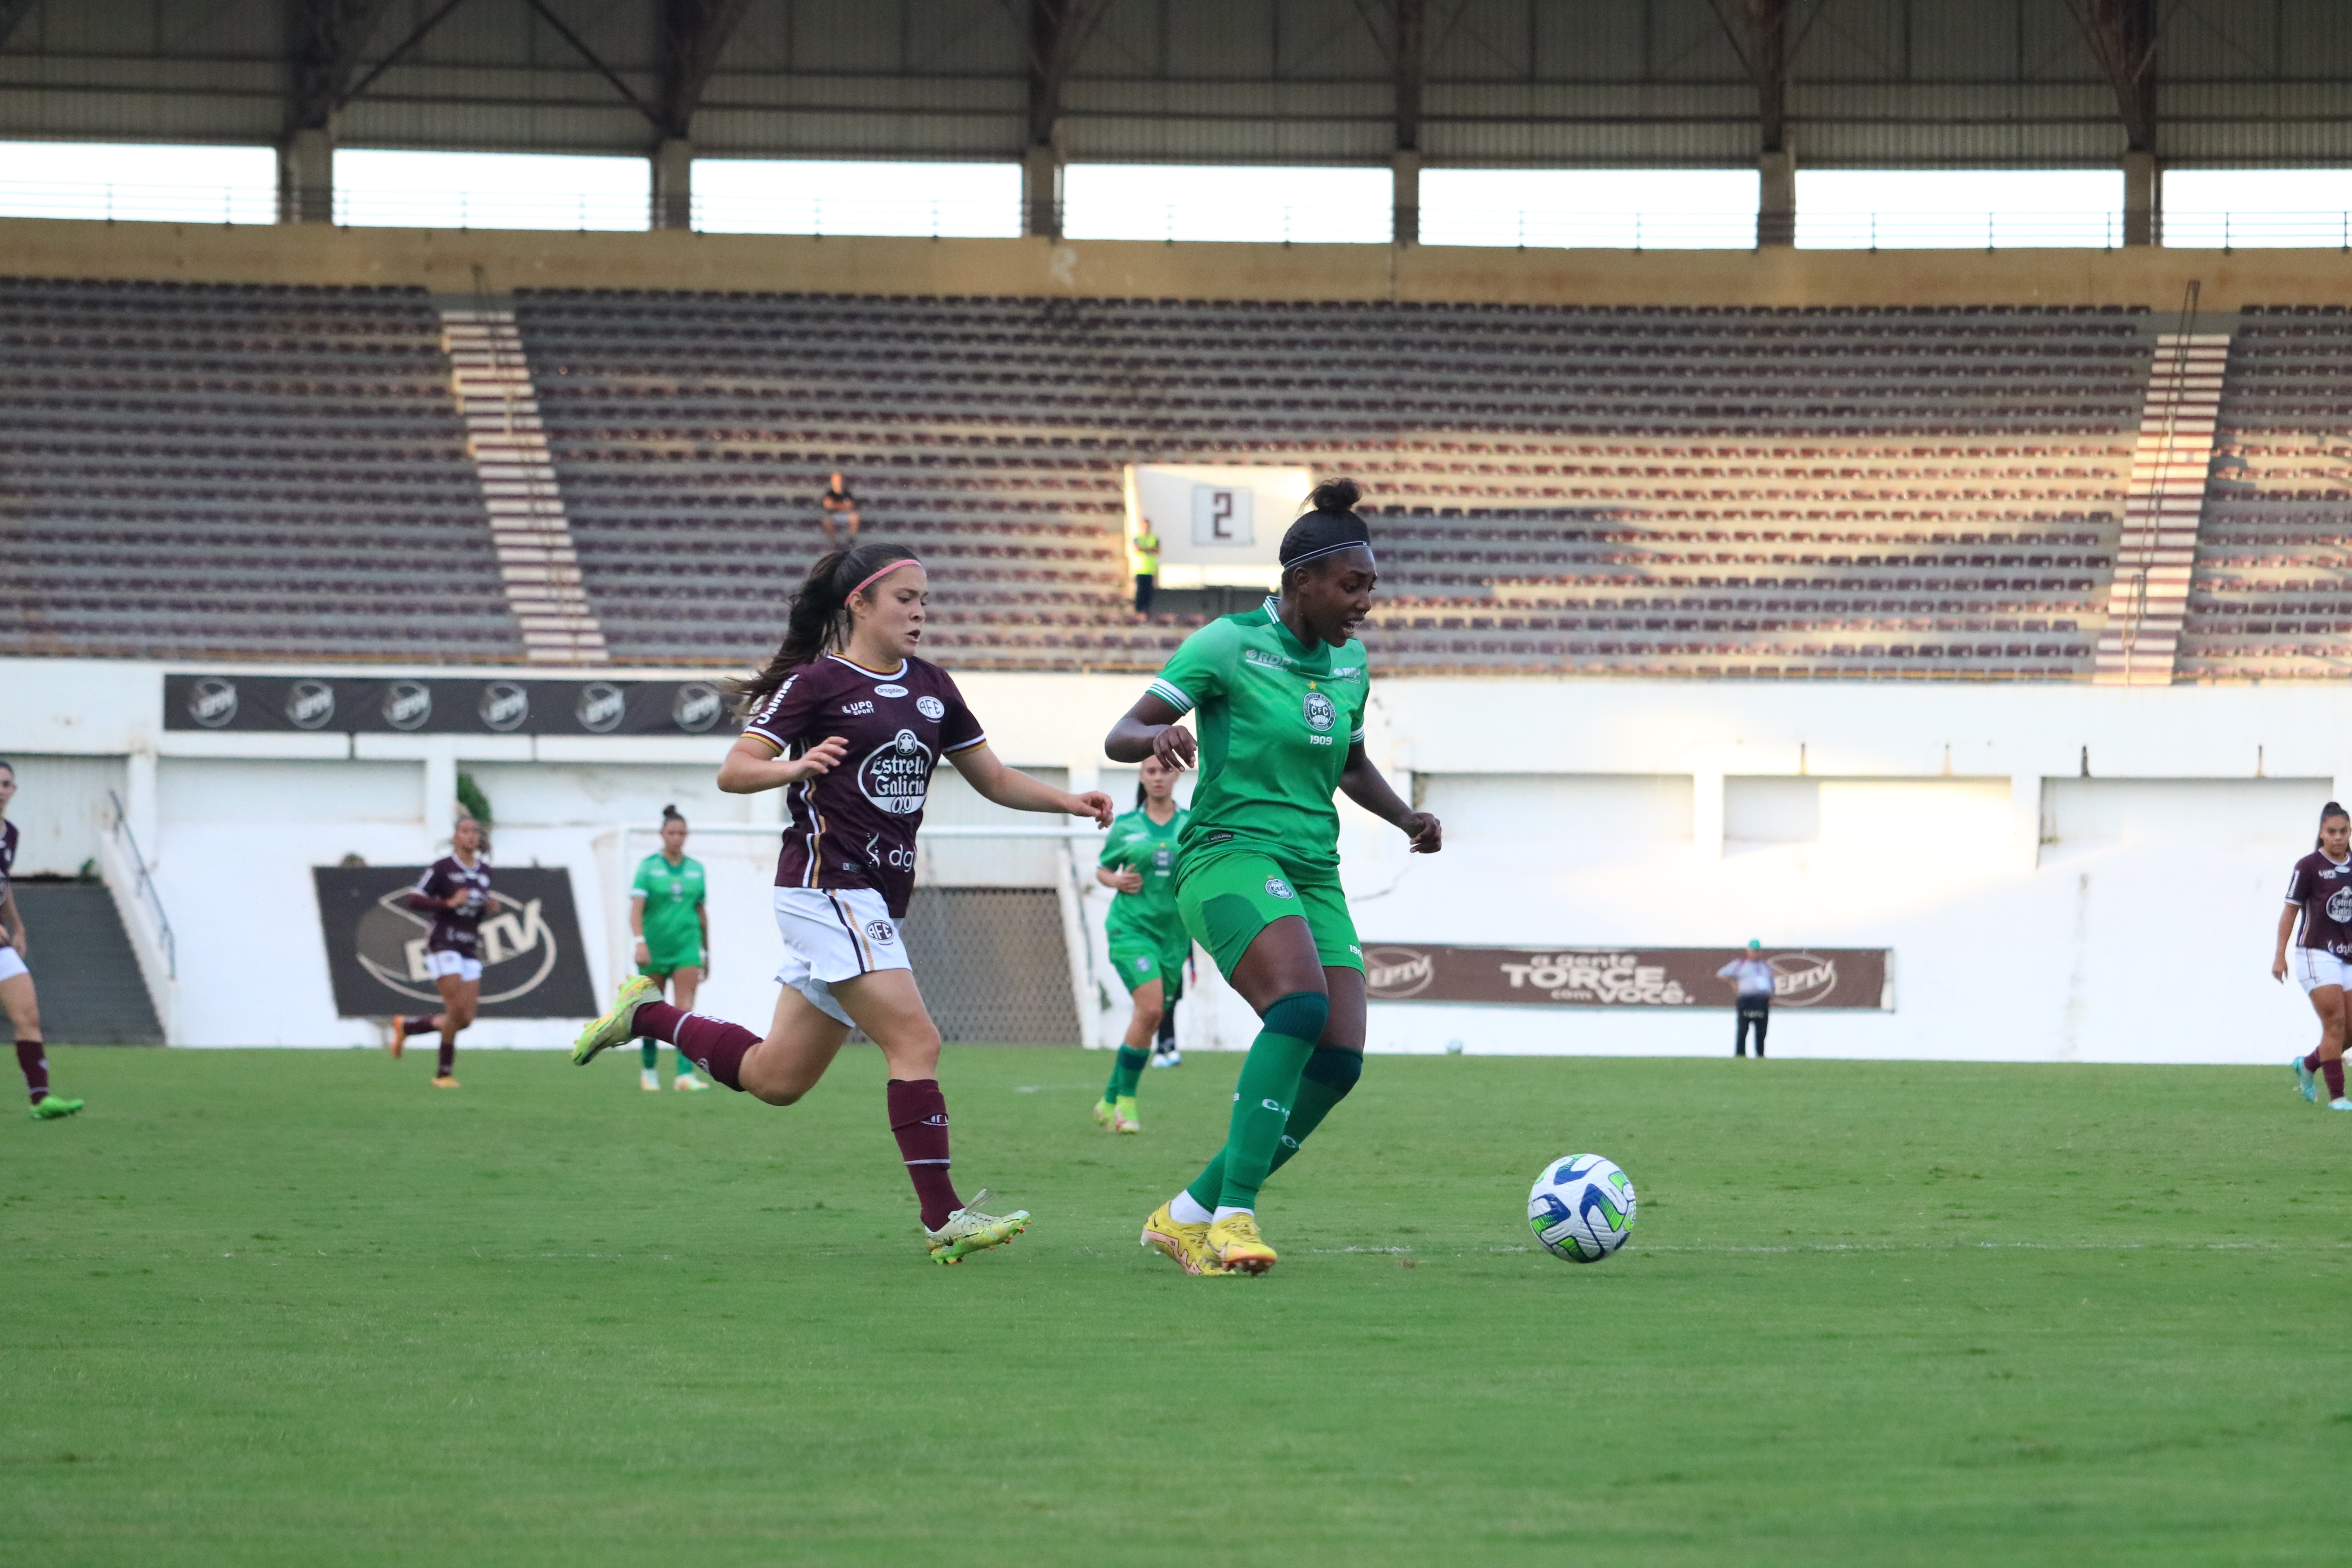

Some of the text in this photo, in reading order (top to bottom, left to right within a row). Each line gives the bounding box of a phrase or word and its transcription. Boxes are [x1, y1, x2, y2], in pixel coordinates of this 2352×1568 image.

[1212, 492, 1232, 537] 2
[842, 701, 873, 713] LUPO
[919, 700, 940, 715] AFE
[1311, 706, 1328, 716] CFC
[1310, 735, 1332, 745] 1909
[405, 898, 541, 980] ETV
[867, 922, 892, 940] AFE
[1500, 964, 1665, 989] TORCE
[1774, 960, 1833, 995] EPTV
[1550, 988, 1593, 1000] com
